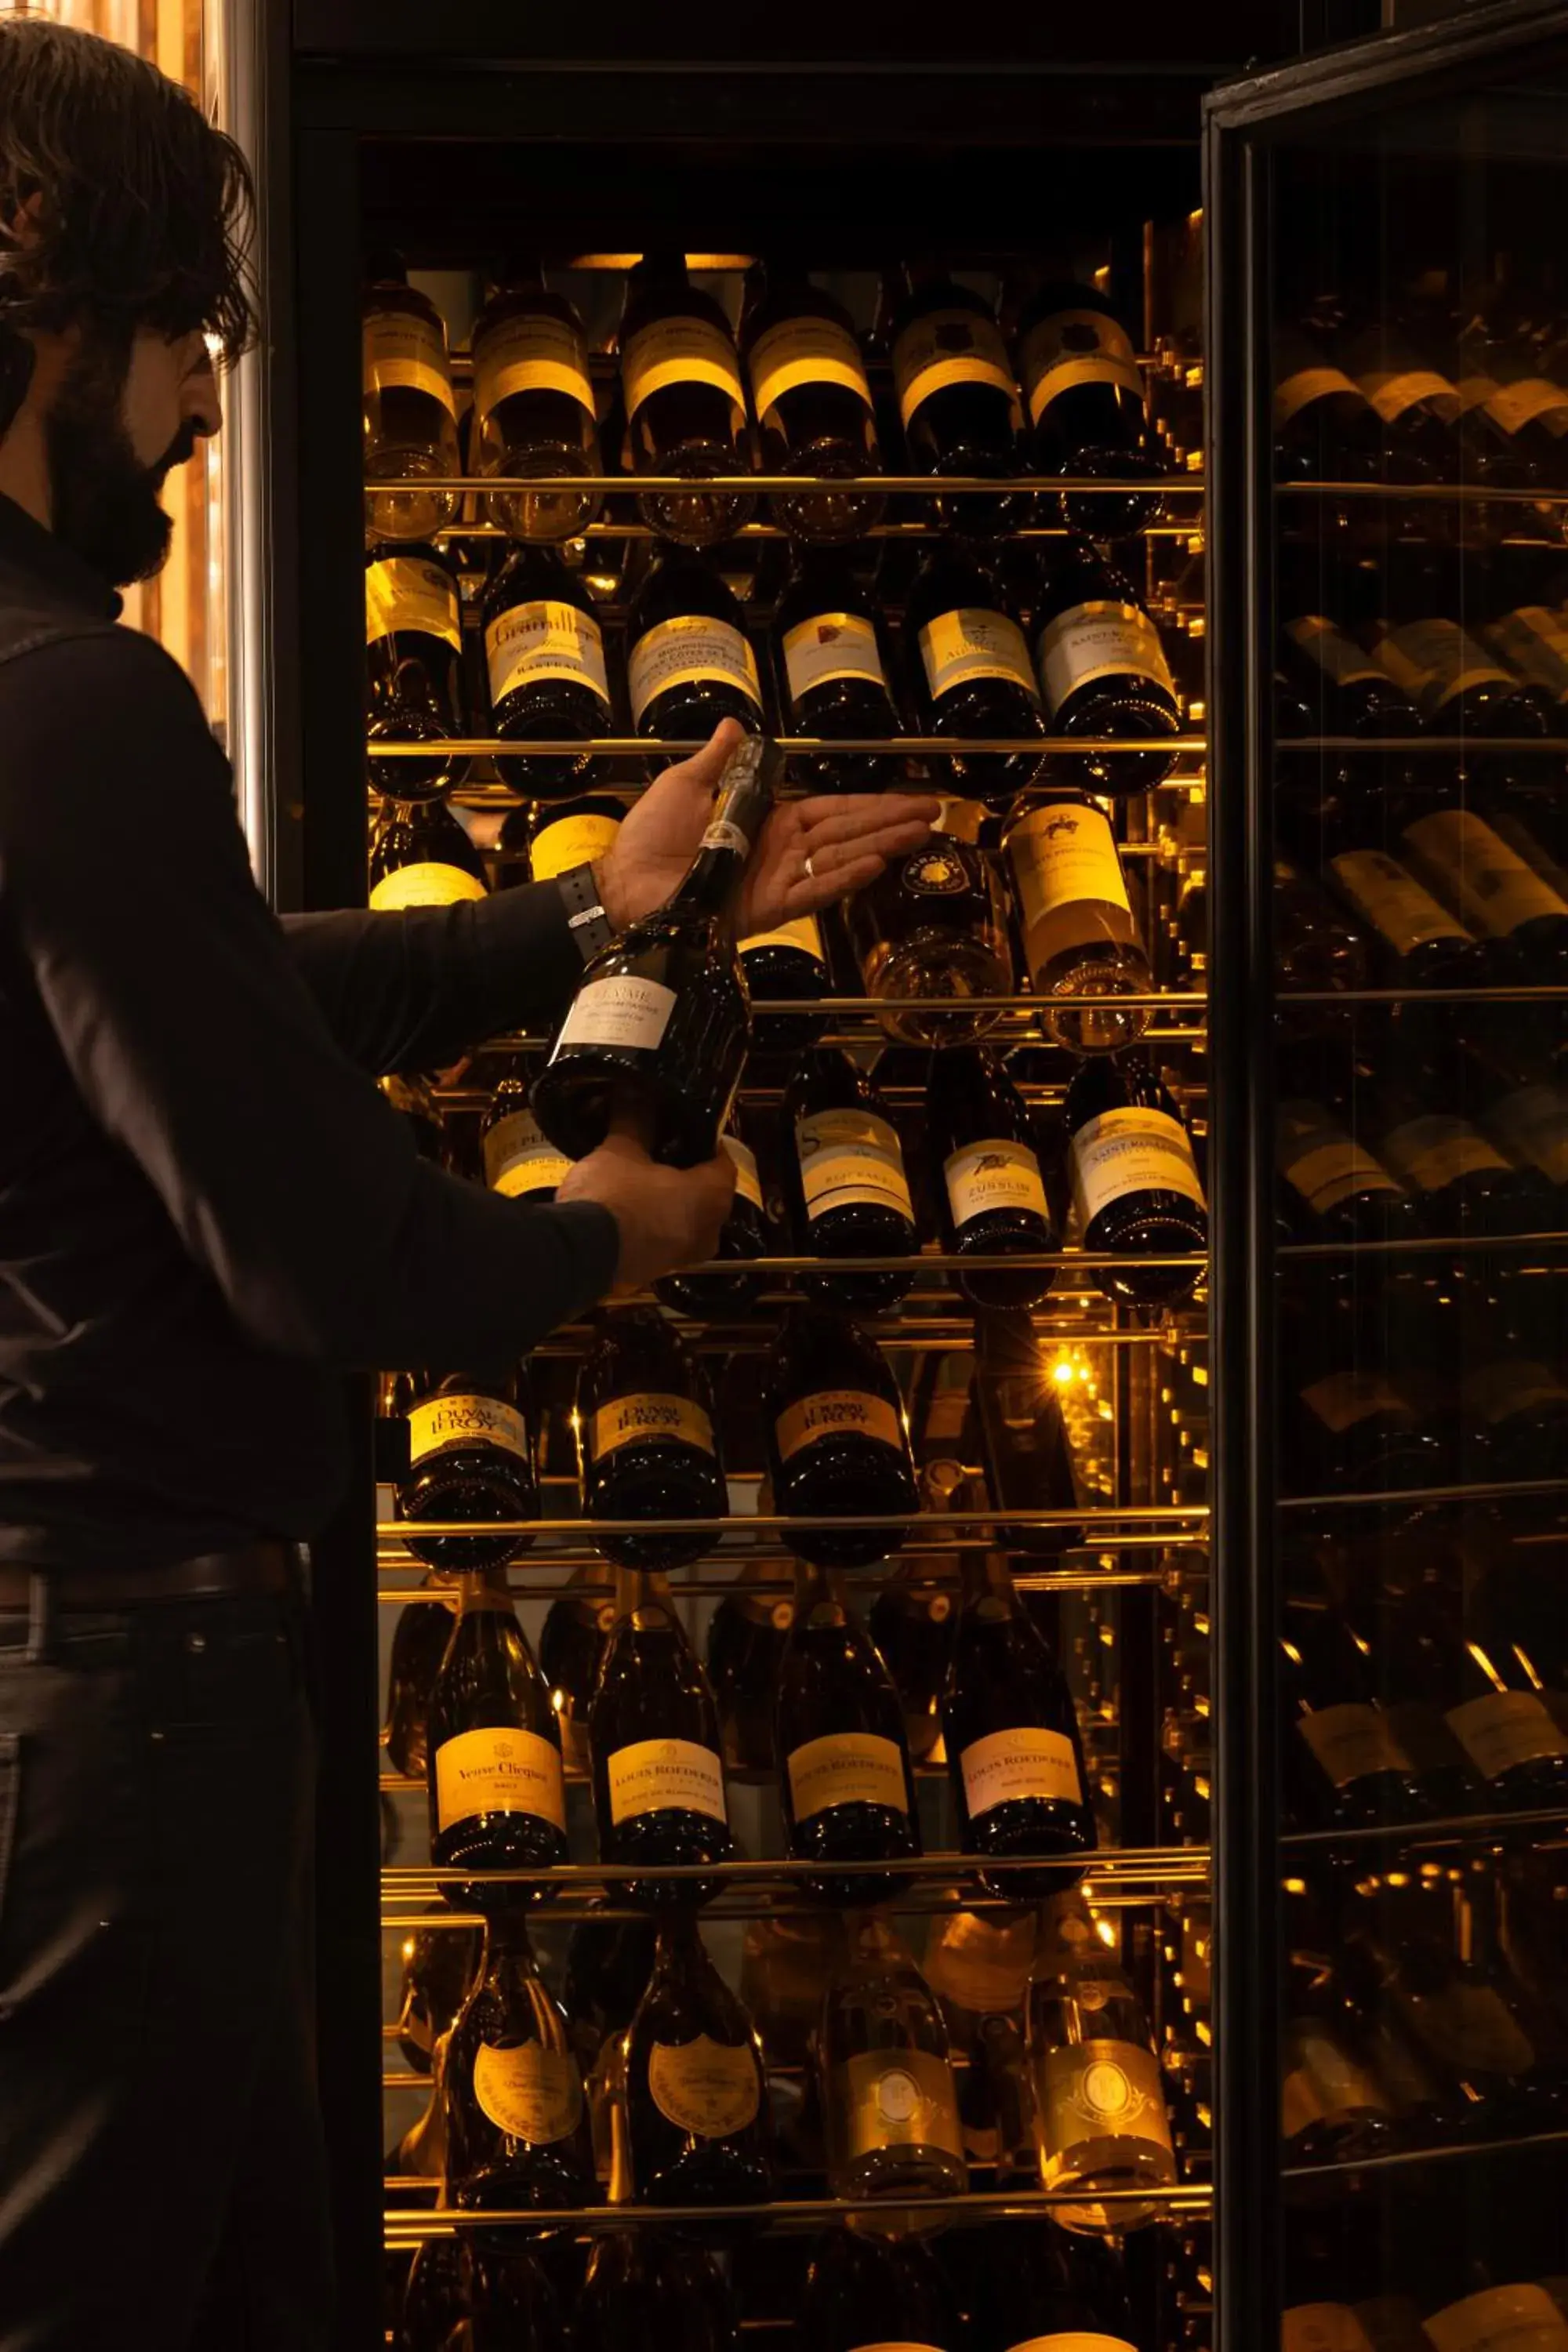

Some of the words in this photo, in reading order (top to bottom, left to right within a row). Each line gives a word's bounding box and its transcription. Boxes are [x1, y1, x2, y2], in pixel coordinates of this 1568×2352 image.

[906, 855, 960, 876] MIRAVAL
[437, 1408, 493, 1422] DUVAL
[624, 1405, 677, 1418] DUVAL
[809, 1402, 862, 1417] DUVAL
[431, 1417, 499, 1436] LEROY
[459, 1766, 496, 1780] Veuve
[498, 1762, 548, 1784] Clicquot
[615, 1768, 652, 1788] LOUIS
